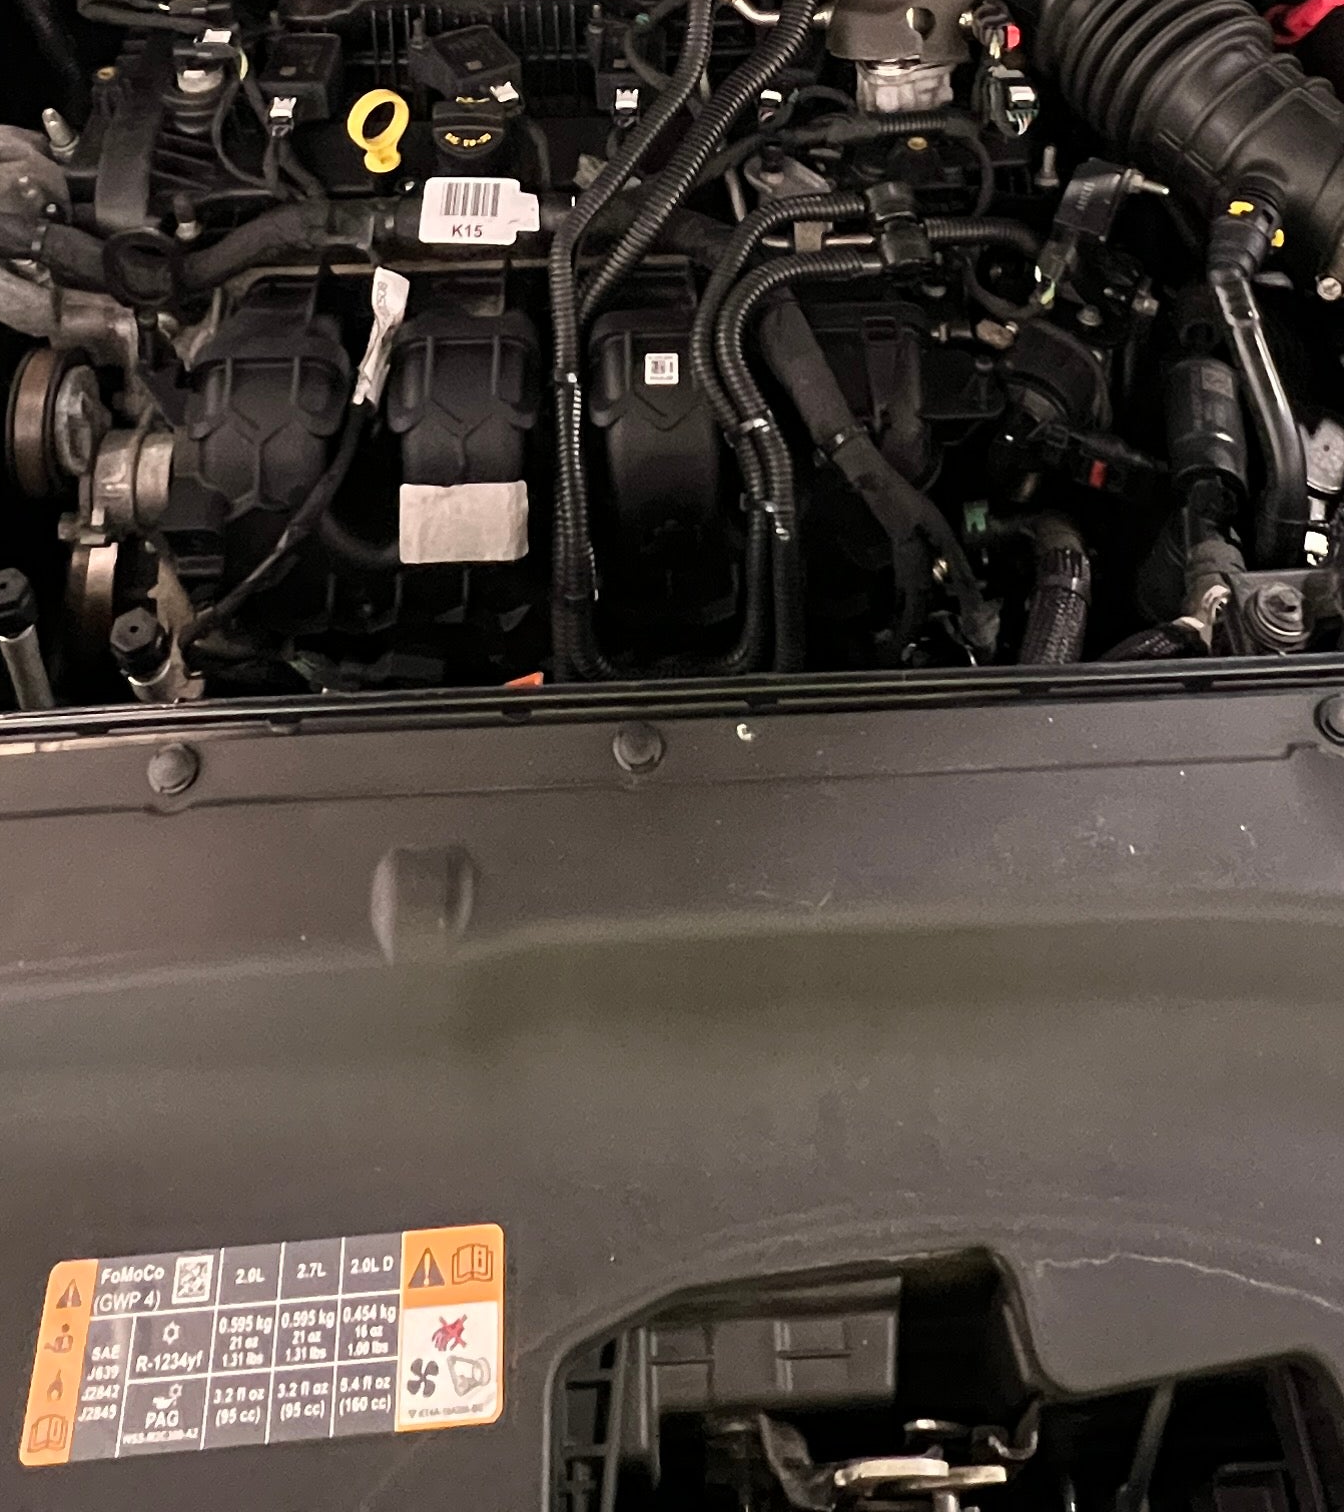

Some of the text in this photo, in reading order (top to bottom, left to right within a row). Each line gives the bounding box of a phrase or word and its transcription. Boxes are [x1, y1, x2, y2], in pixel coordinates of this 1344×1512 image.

[452, 224, 484, 238] K15
[296, 1263, 326, 1279] 2.7L
[350, 1255, 394, 1274] 2.0L D
[100, 1264, 165, 1285] FoMoCo
[235, 1268, 265, 1285] 2.0L
[93, 1291, 161, 1315] (GWP 4)
[280, 1308, 335, 1329] 0.595 kg
[343, 1303, 396, 1324] 0.454 kg
[218, 1314, 273, 1335] 0.595 kg
[229, 1337, 243, 1351] 21
[292, 1331, 306, 1345] 21
[91, 1344, 120, 1361] SAE
[135, 1350, 204, 1373] R-1234yf
[222, 1352, 243, 1367] 1.31
[285, 1347, 306, 1362] 1.31
[277, 1382, 298, 1399] 3.2
[313, 1382, 329, 1395] oz
[375, 1376, 391, 1389] oz
[213, 1388, 233, 1405] 3.2
[249, 1388, 265, 1401] oz
[371, 1394, 392, 1414] cc)
[144, 1410, 180, 1429] PAG
[215, 1405, 261, 1428] (95 cc)
[280, 1399, 325, 1422] (95 cc)
